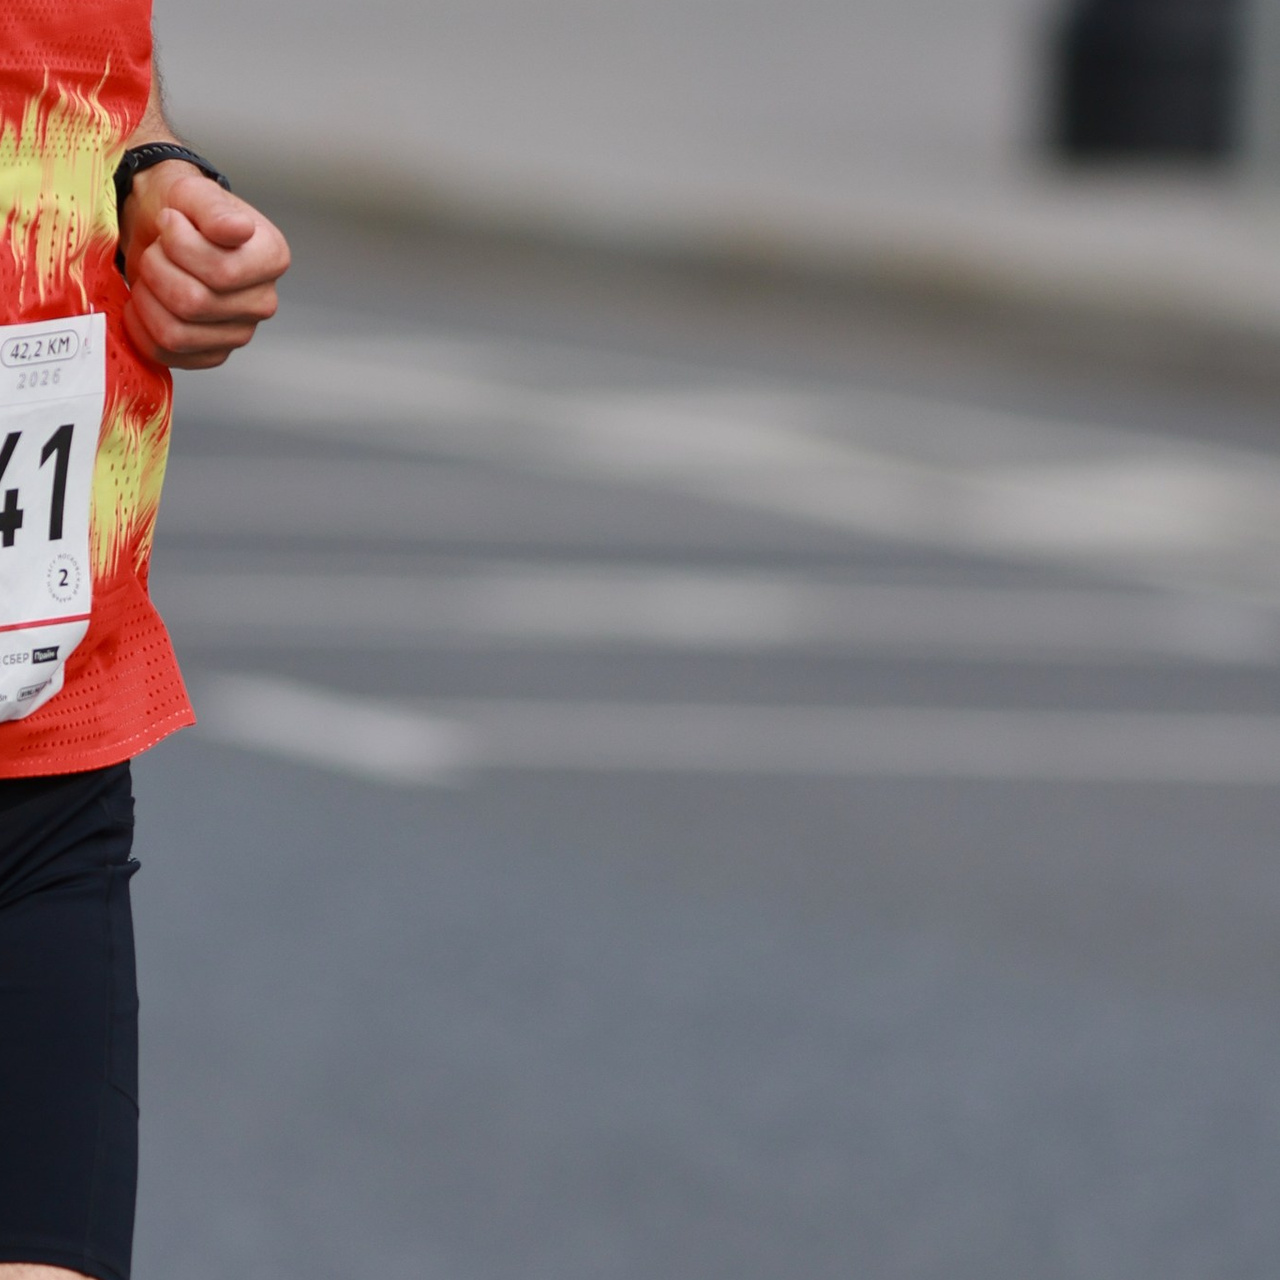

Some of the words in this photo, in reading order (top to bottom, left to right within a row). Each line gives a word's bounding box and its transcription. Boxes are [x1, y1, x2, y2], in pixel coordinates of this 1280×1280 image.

[9, 342, 44, 360] 42,2
[47, 336, 71, 356] КМ
[16, 367, 62, 389] 2026
[58, 568, 69, 587] 2
[2, 653, 30, 666] СБЕР
